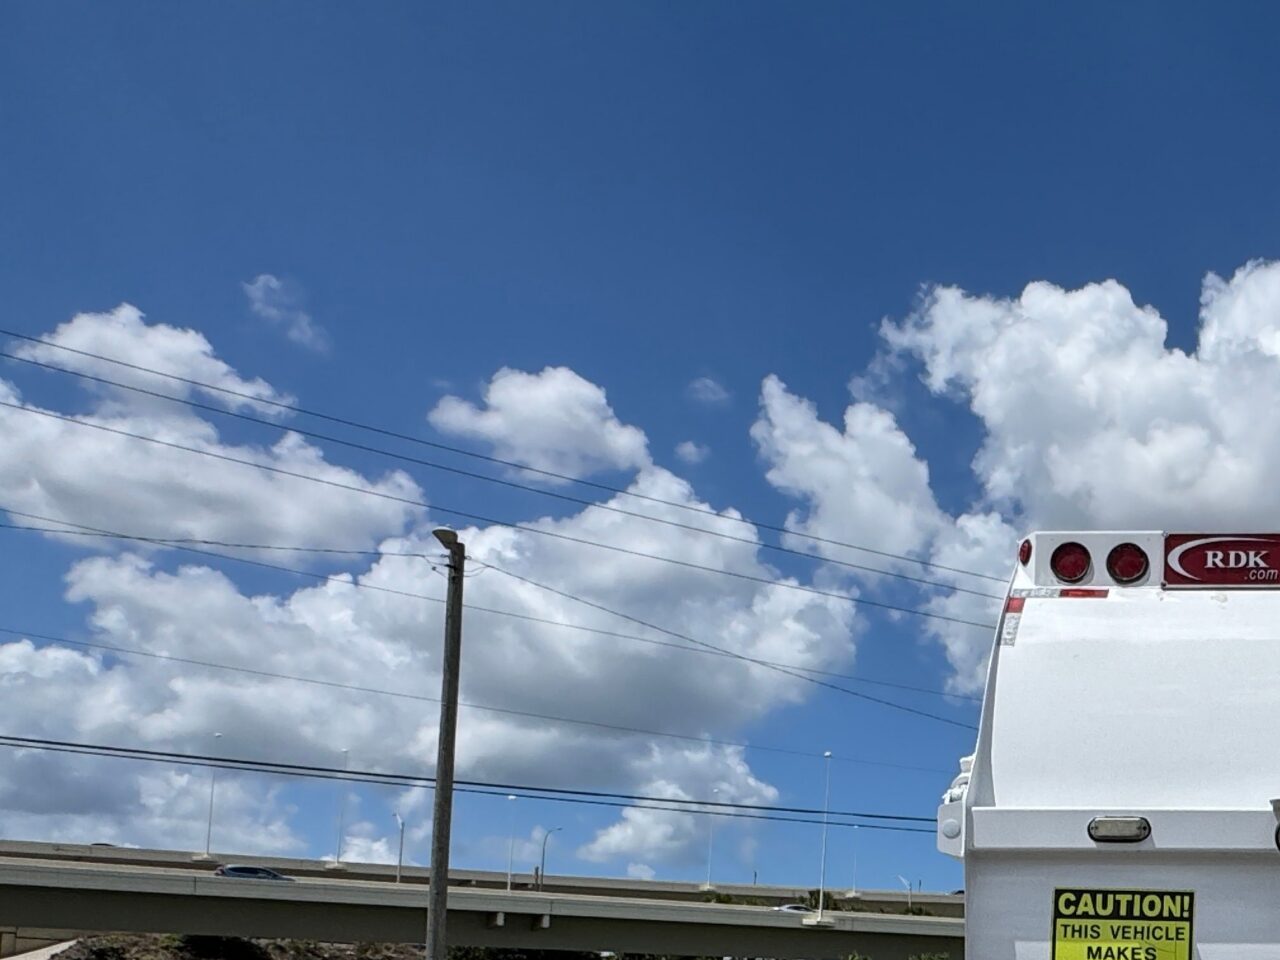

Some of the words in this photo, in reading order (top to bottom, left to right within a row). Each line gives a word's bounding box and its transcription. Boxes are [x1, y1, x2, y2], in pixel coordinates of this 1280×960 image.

[1204, 550, 1270, 569] RDK
[1243, 569, 1279, 581] .com
[1057, 892, 1190, 918] CAUTION!
[1060, 924, 1101, 940] THIS
[1110, 925, 1186, 941] VEHICLE
